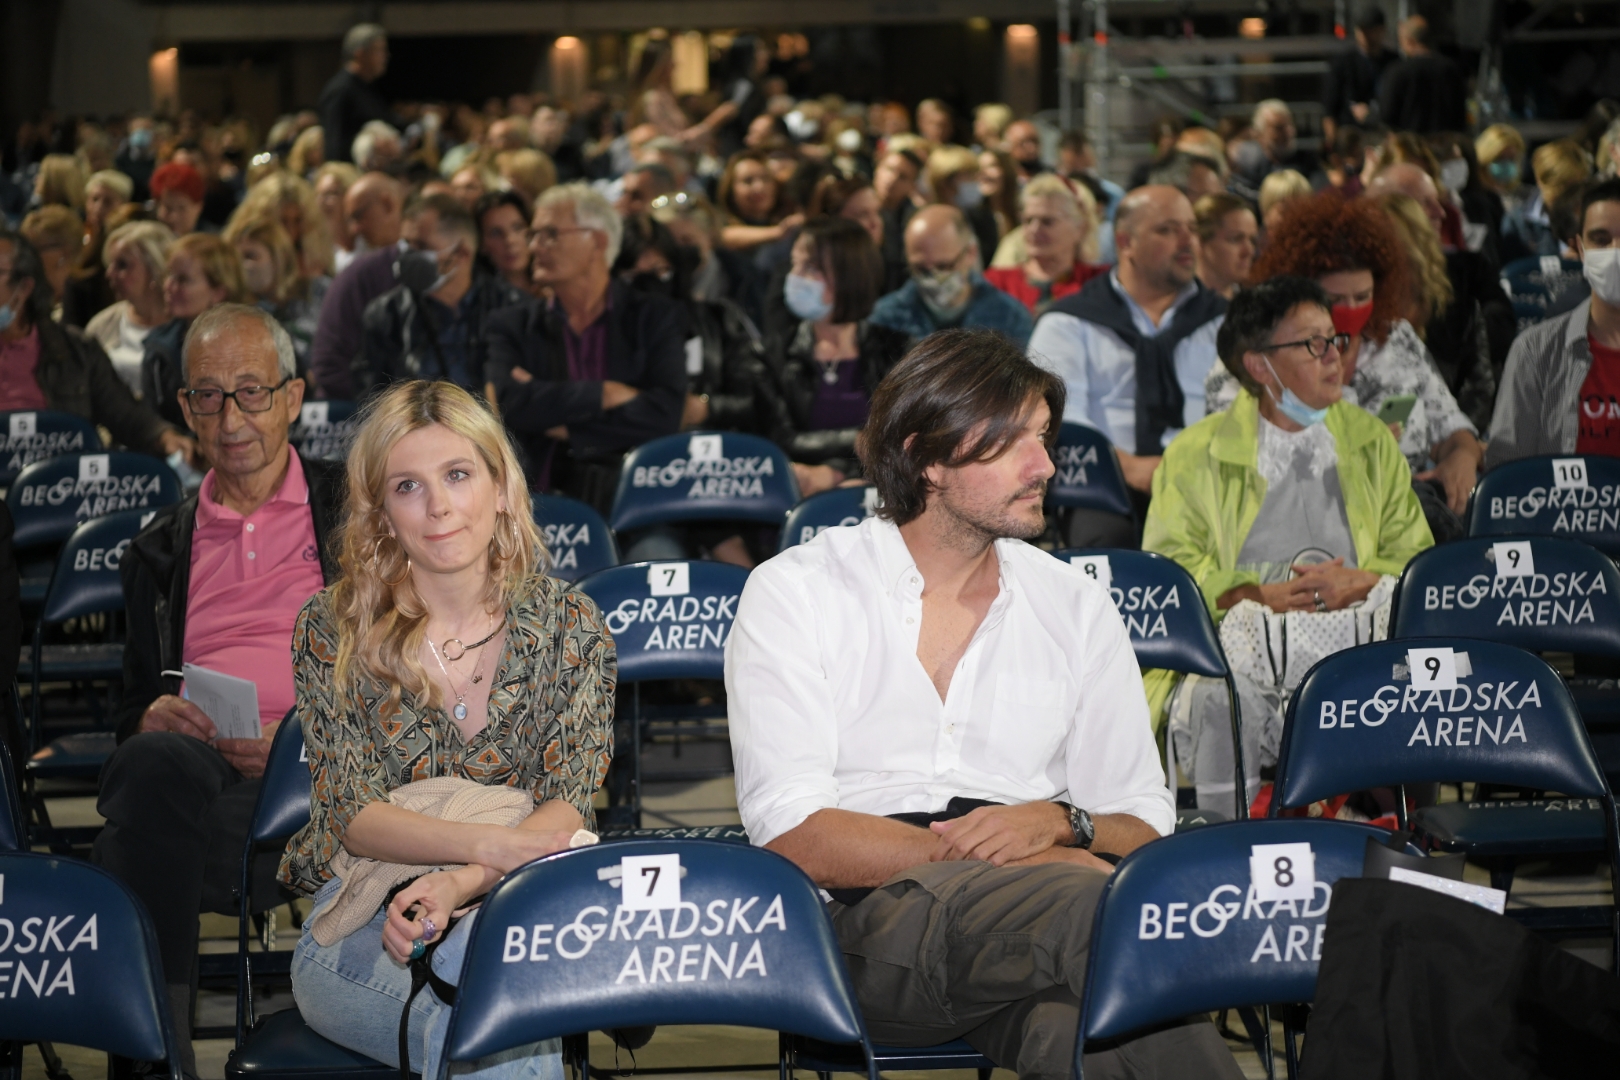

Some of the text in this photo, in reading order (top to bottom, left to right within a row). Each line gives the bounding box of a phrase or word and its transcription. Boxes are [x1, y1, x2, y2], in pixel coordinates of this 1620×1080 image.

[633, 456, 775, 487] BEOGRADSKA
[1558, 465, 1582, 482] 10
[21, 475, 161, 506] BEOGRADSKA
[687, 477, 765, 498] ARENA
[543, 523, 590, 546] SKA
[1553, 508, 1620, 532] AREN
[1084, 563, 1098, 580] 8
[1507, 549, 1521, 568] 9
[663, 569, 677, 587] 7
[1424, 570, 1607, 611] BEOGRADSKA
[602, 595, 739, 635] OGRADSK
[1496, 598, 1595, 627] ARENA
[643, 623, 729, 651] AREN
[1424, 657, 1441, 681] 9
[1319, 679, 1542, 729] BEOGRADSKA
[1407, 714, 1528, 747] ARENA
[661, 830, 746, 839] AREN
[640, 866, 661, 897] 7
[1273, 856, 1294, 887] 8
[502, 893, 788, 963] BEOGRADSKA
[615, 938, 768, 985] ARENA
